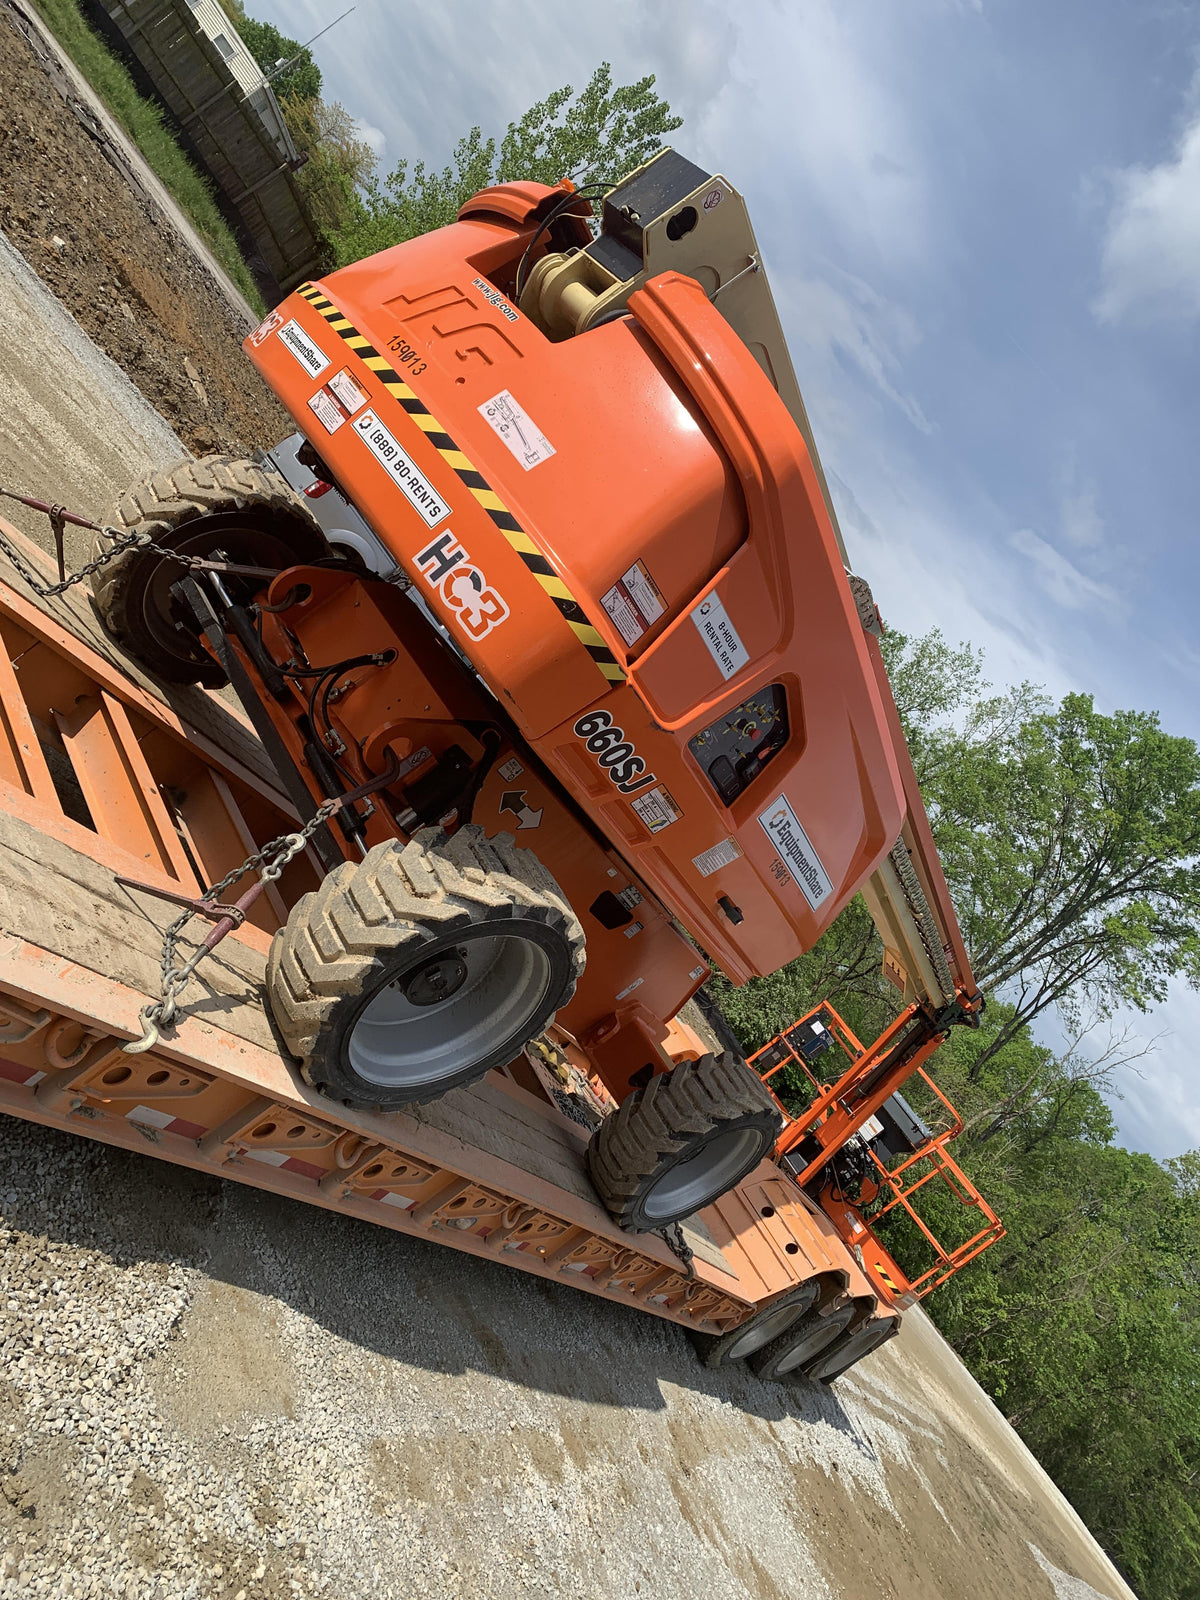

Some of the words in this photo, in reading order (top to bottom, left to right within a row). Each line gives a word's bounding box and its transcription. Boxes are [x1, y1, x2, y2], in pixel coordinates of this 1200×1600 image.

[472, 278, 520, 322] www.jlg.com
[285, 327, 321, 371] EquipmentShare
[386, 335, 427, 376] 159013
[369, 429, 399, 462] (888)
[393, 460, 441, 518] 80-RENTS
[412, 528, 510, 642] HC3
[626, 599, 640, 617] DANGER
[703, 621, 722, 653] RENTAL
[719, 651, 735, 672] RATE
[718, 621, 738, 653] 8-HOUR
[573, 709, 657, 794] 660SJ
[777, 820, 825, 899] EquipmentShare
